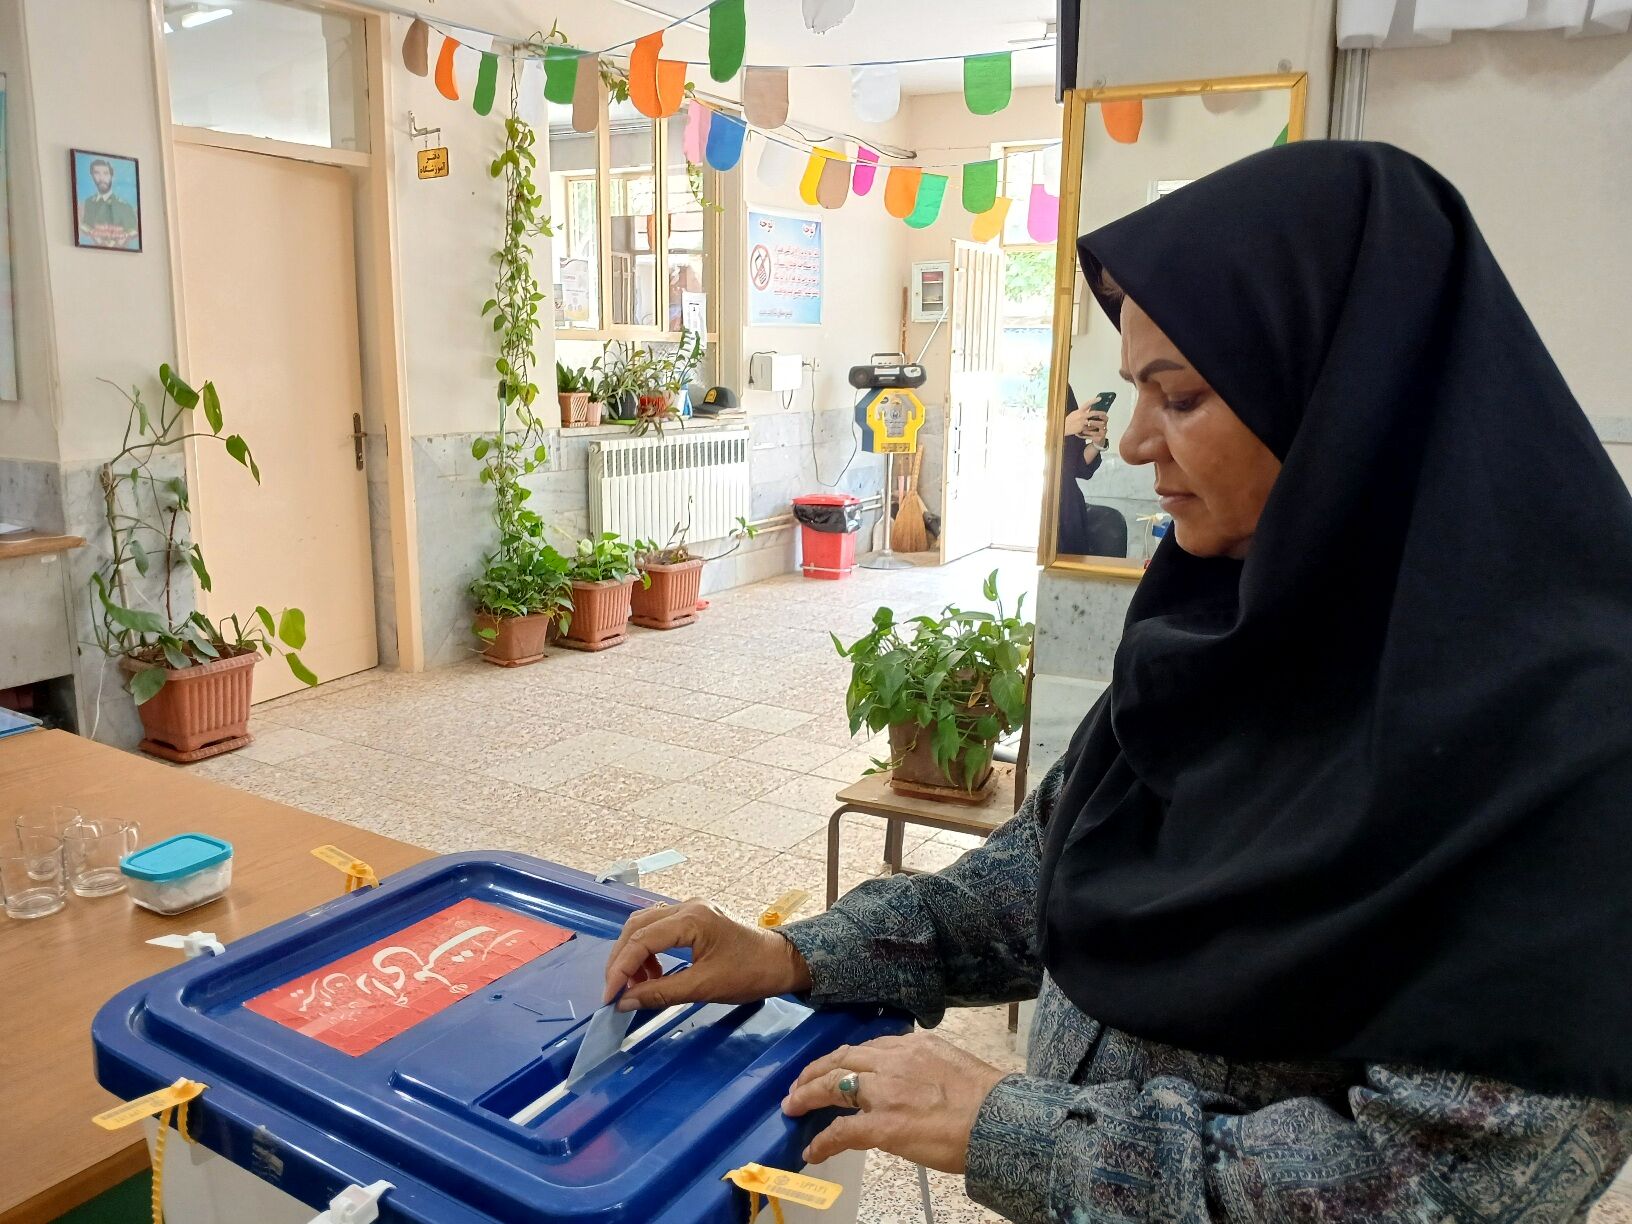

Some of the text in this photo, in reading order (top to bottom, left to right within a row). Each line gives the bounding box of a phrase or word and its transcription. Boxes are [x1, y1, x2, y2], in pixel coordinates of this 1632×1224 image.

[426, 153, 441, 163] دفتر
[420, 162, 445, 174] آموزشگاه
[289, 972, 352, 1012] میزان
[413, 925, 497, 986] ملت
[471, 929, 525, 961] است
